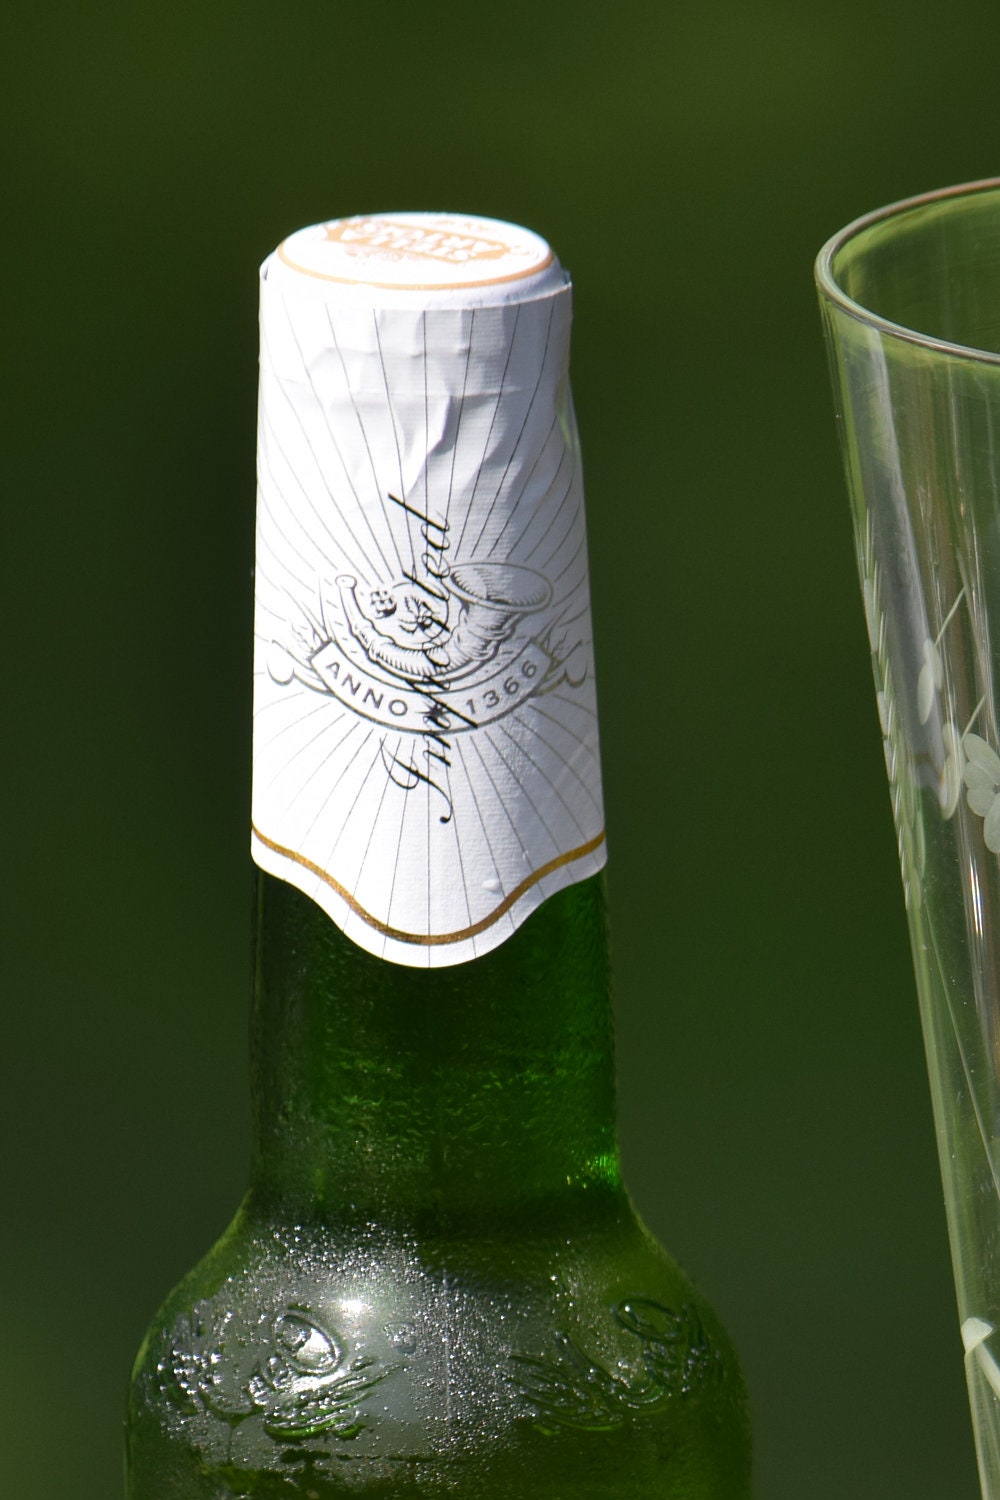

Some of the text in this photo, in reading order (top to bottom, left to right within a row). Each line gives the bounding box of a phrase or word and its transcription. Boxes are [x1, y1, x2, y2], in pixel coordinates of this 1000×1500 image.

[325, 659, 538, 717] ANNO 1366
[380, 493, 478, 824] Imported
